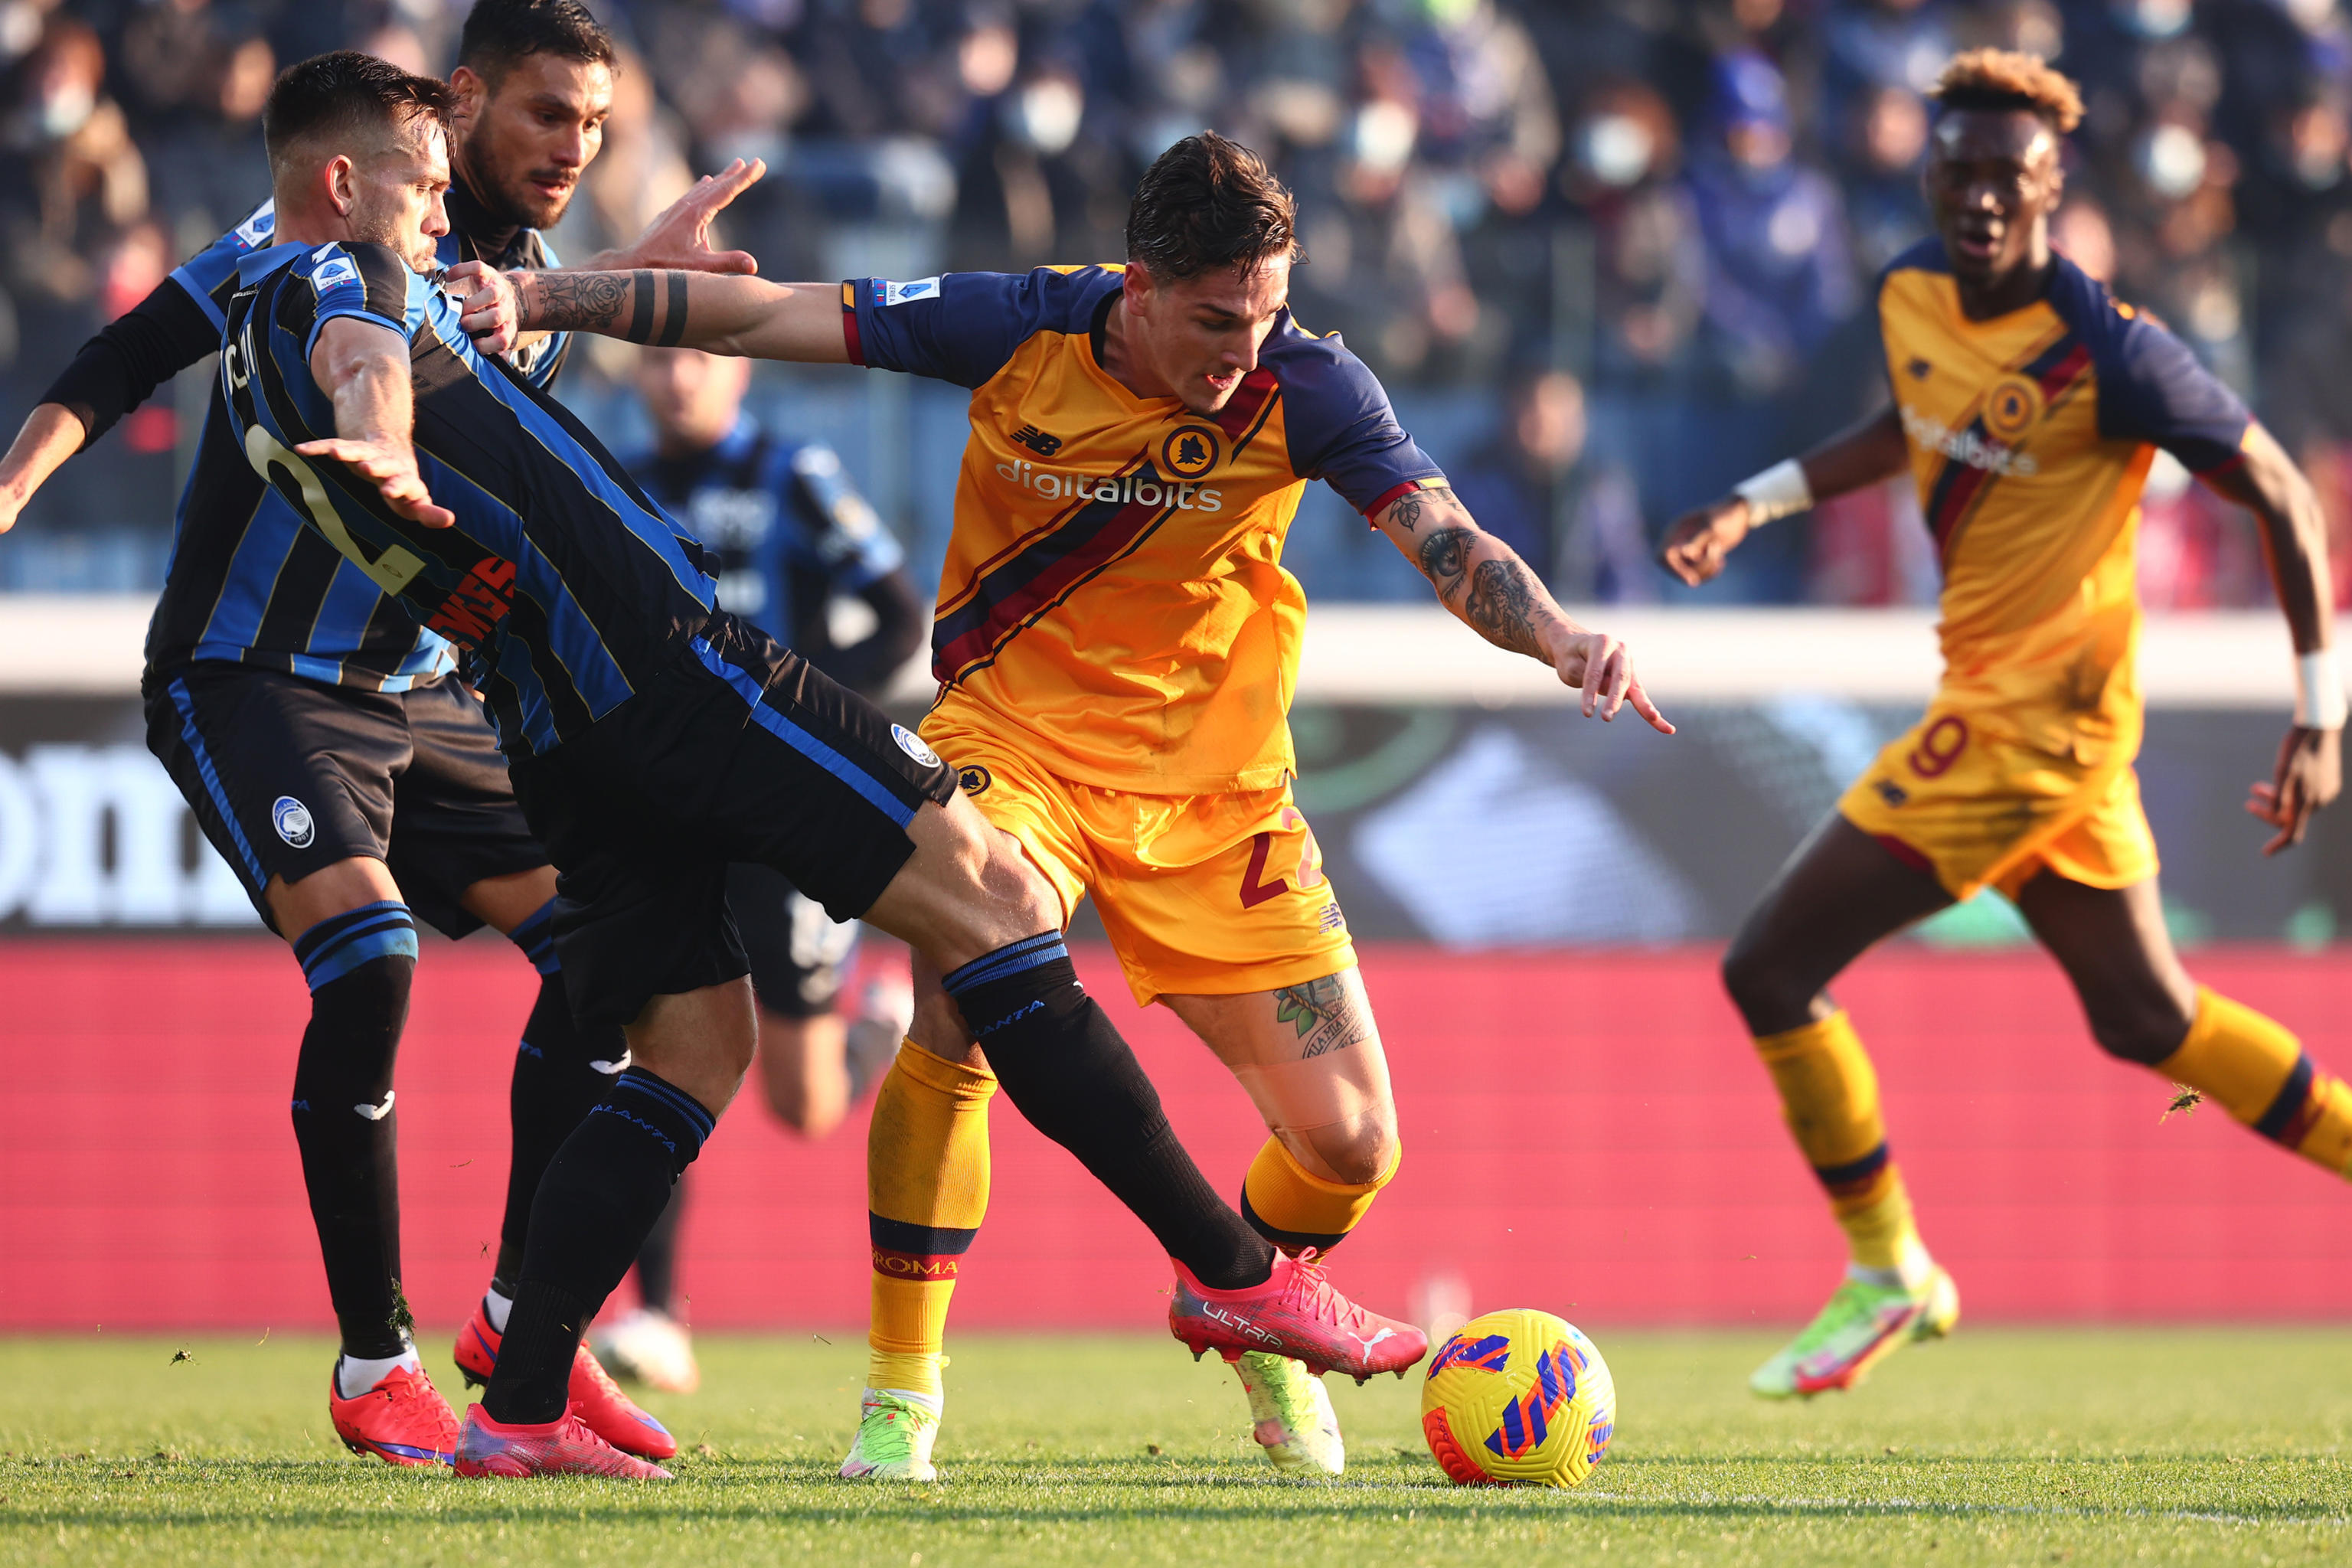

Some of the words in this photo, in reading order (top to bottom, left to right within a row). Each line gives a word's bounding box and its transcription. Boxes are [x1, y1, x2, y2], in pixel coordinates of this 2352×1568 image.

[244, 423, 427, 598] 2
[995, 459, 1223, 512] digitalbits
[1908, 715, 1969, 782] 9
[874, 1251, 959, 1276] ROMA
[1203, 1301, 1283, 1348] ULTRA
